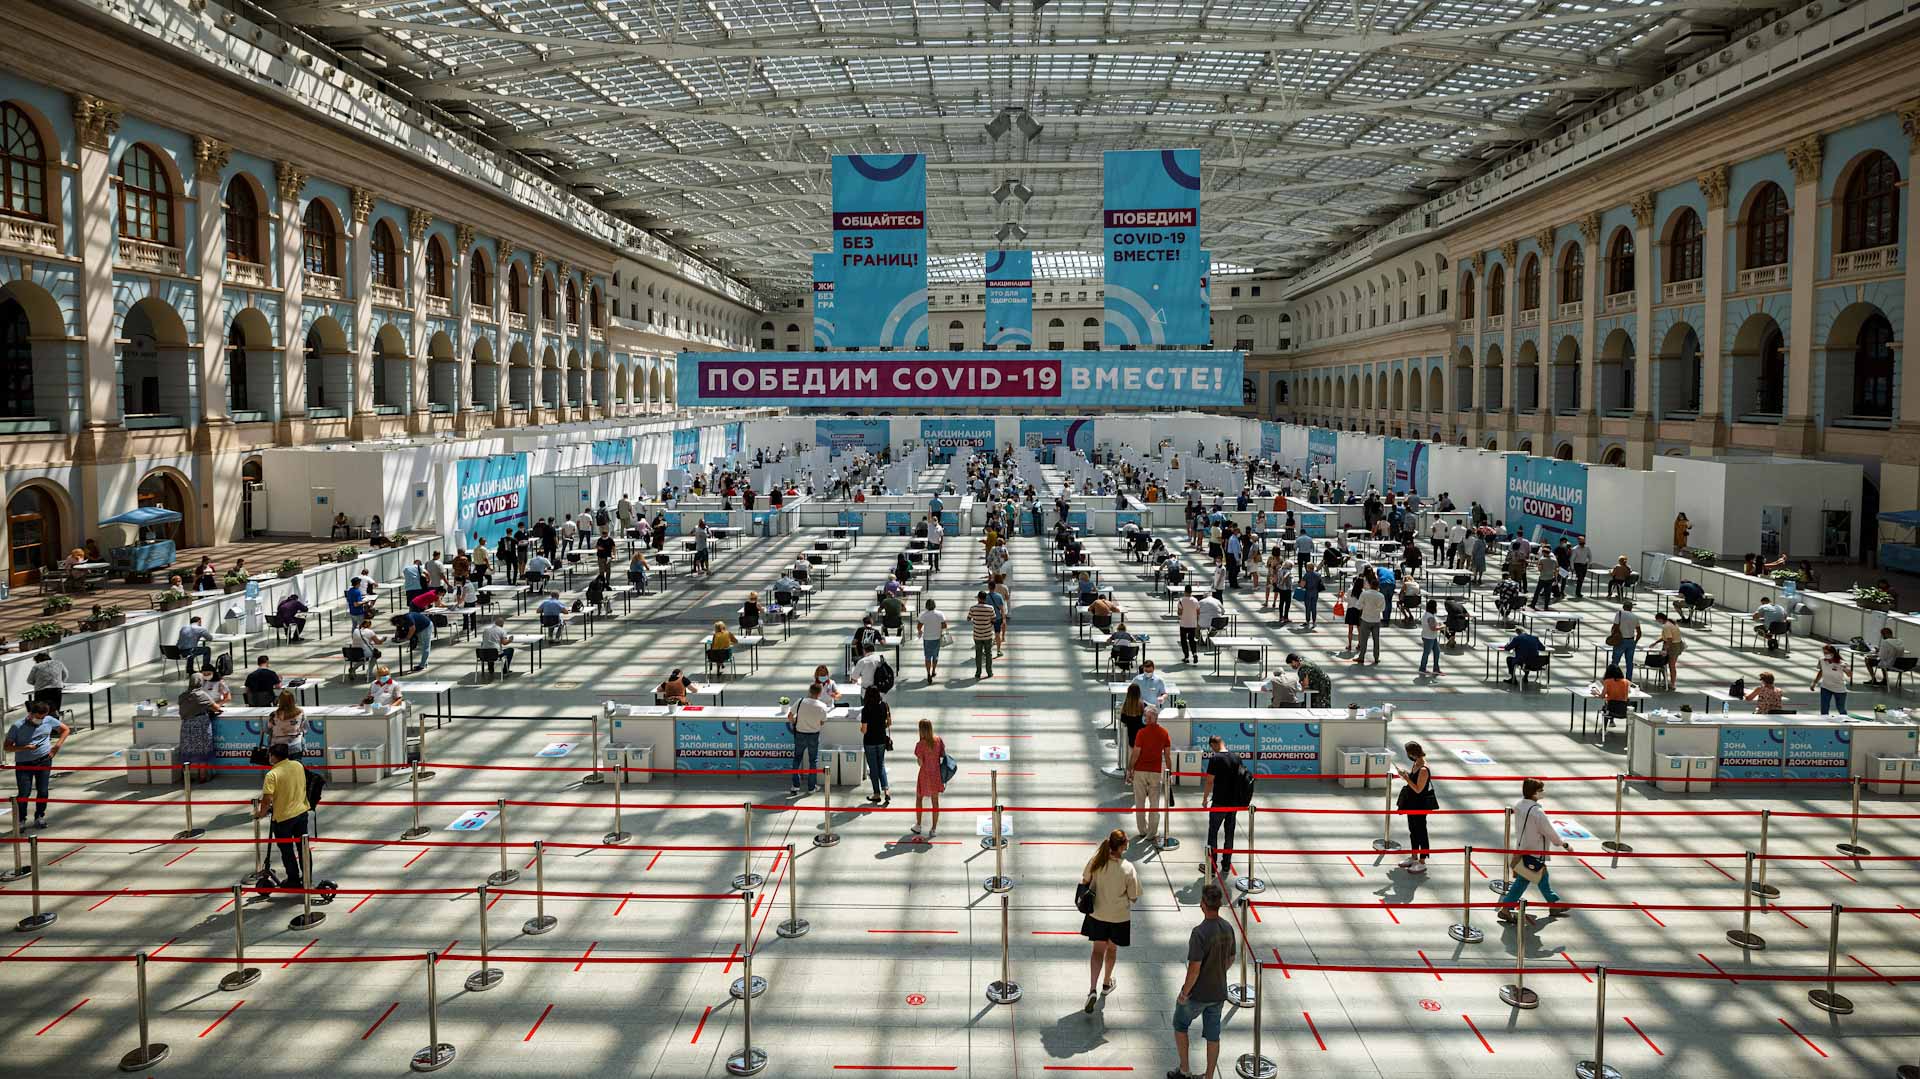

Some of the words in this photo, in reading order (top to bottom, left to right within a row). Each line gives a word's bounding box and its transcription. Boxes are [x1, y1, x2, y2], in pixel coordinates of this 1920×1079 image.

[841, 213, 921, 228] ОБЩАЙТЕСЬ
[1112, 210, 1193, 227] ПОБЕДИМ
[842, 236, 874, 250] БЕЗ
[1113, 231, 1187, 246] COVID-19
[842, 253, 919, 268] ГРАНИЦ!
[1113, 249, 1181, 263] ВМЕСТЕ!
[817, 282, 834, 291] ЖИ
[989, 280, 1031, 288] ВАКЦИНАЦИЯ
[707, 367, 878, 395] ПОБЕДИМ
[892, 366, 1058, 391] COVID-19
[1071, 366, 1224, 390] ВМЕСТЕ!
[924, 430, 992, 439] ВАКЦИНАЦИЯ
[939, 439, 984, 447] COVID-19
[461, 474, 525, 501] ВАКЦИНАЦИЯ
[1509, 476, 1583, 505] ВАКЦИНАЦИЯ
[461, 502, 476, 520] ОТ
[477, 493, 519, 516] COVID-19
[1509, 495, 1522, 511] ОТ
[1523, 498, 1573, 523] COVID-19
[743, 734, 766, 742] ЗОНА
[1261, 744, 1315, 752] ЗАПОЛНЕНИЯ
[679, 749, 734, 757] ДОКУМЕНТОВ
[1260, 752, 1316, 760] ДОКУМЕНТОВ
[1723, 750, 1779, 758] ЗАПОЛНЕНИЯ
[1789, 751, 1845, 759] ЗАПОЛНЕНИЯ
[1723, 758, 1779, 766] ДОКУМЕНТОВ
[1789, 759, 1845, 767] ДОКУМЕНТОВ
